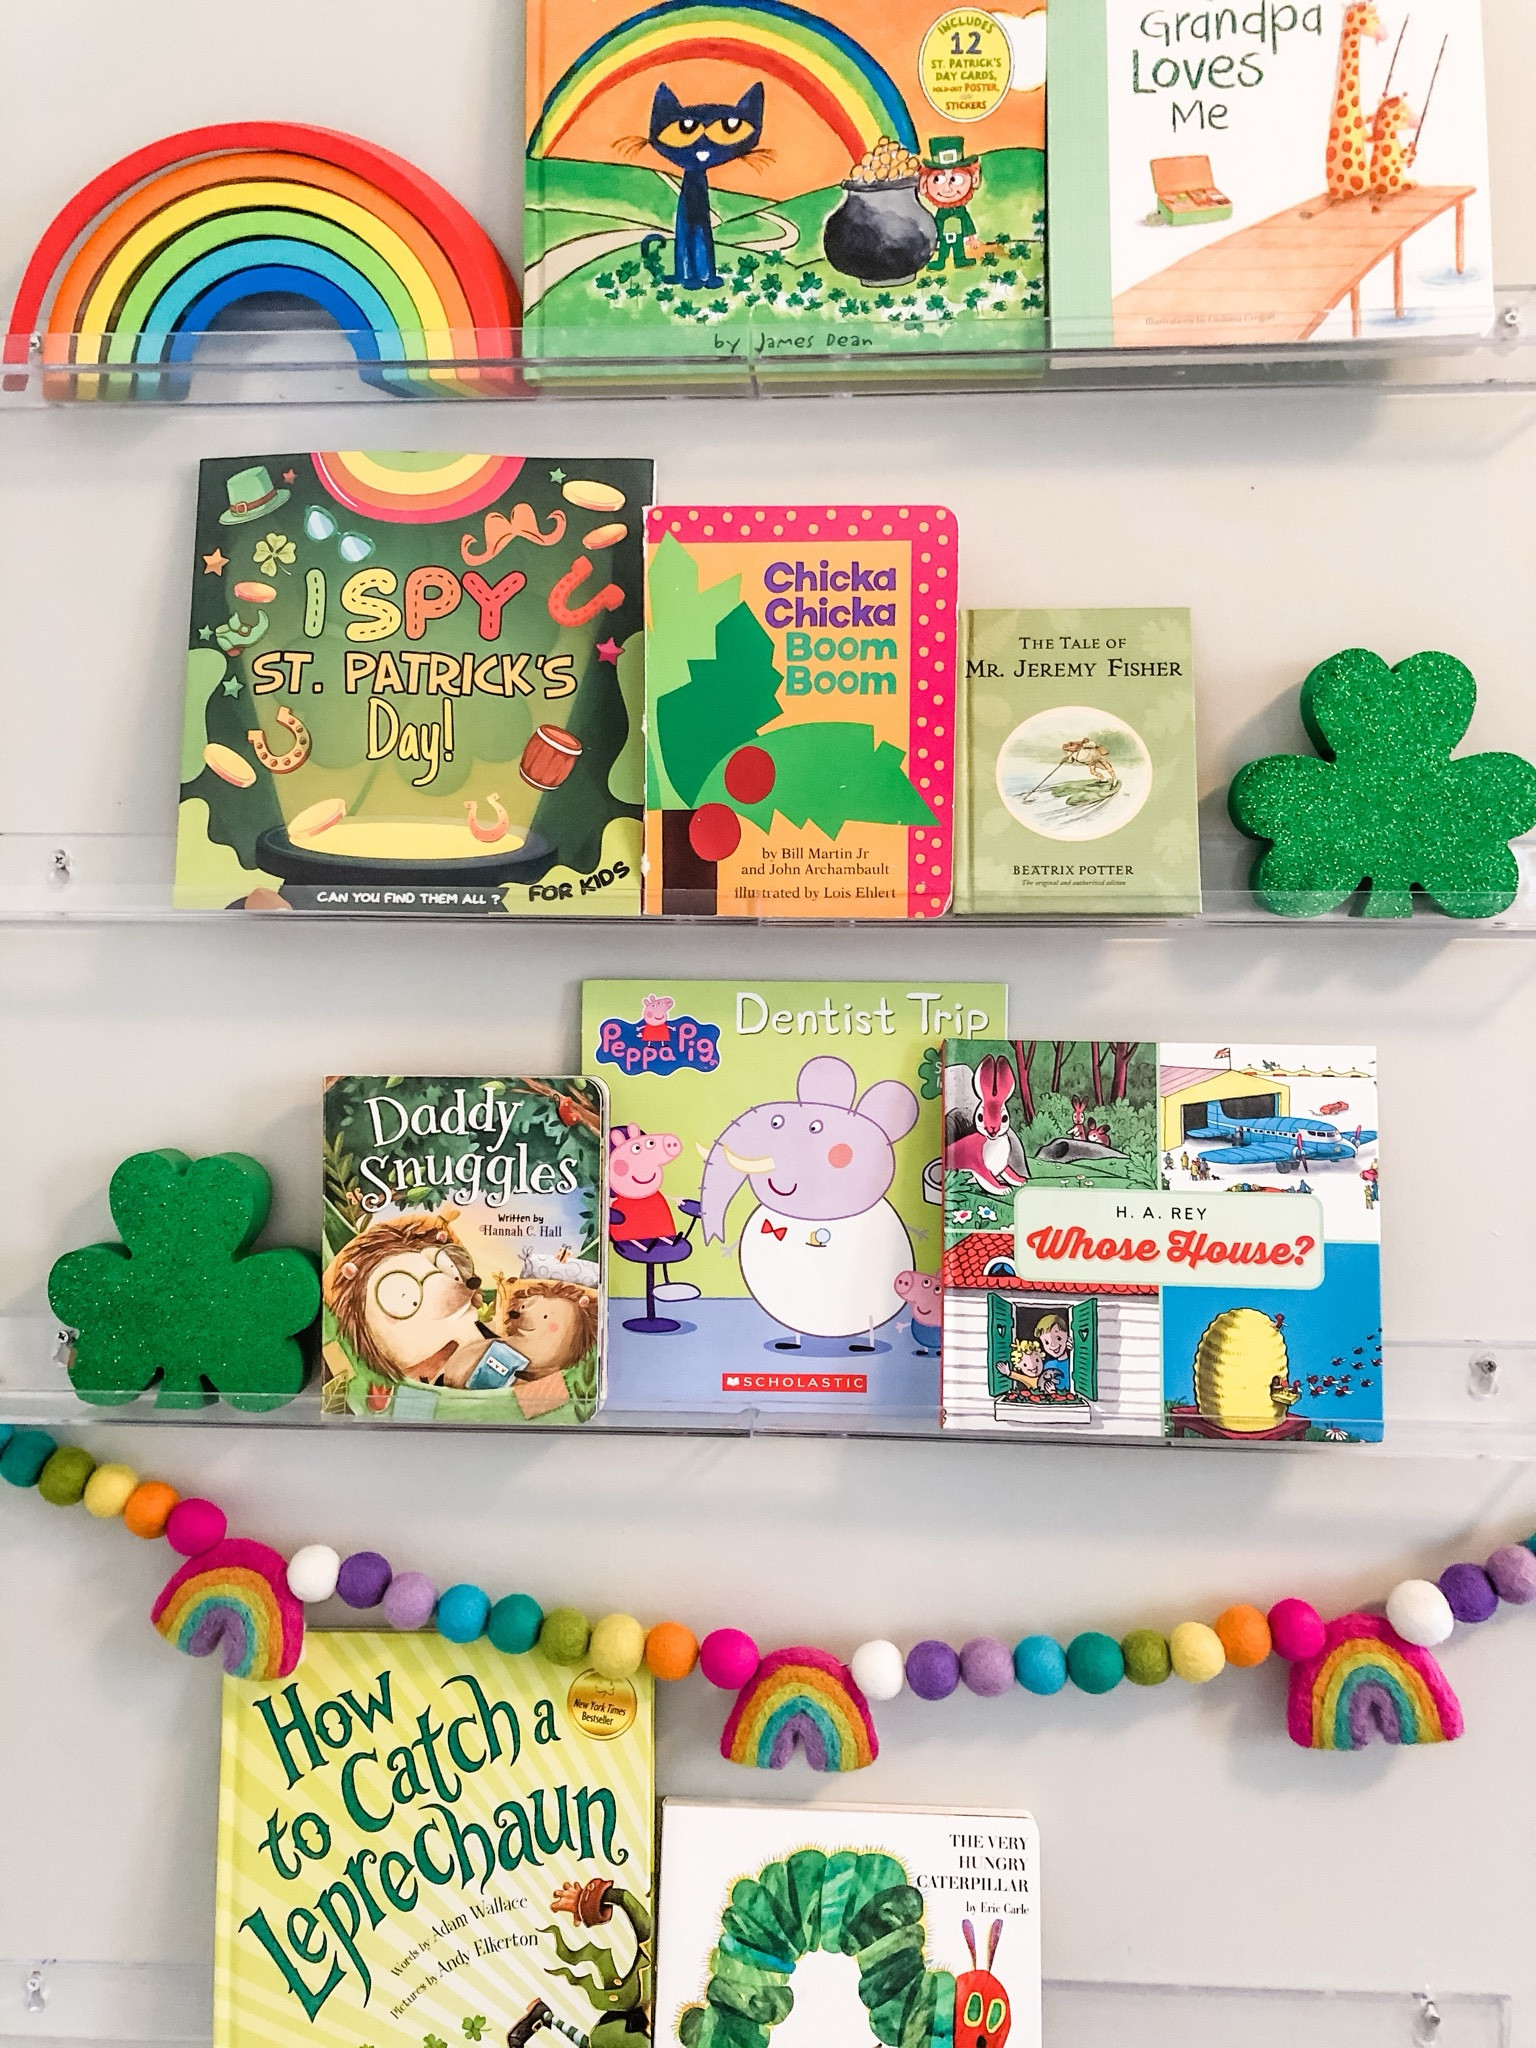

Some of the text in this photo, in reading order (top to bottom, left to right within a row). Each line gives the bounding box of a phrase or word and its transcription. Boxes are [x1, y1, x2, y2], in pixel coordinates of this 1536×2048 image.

[937, 16, 995, 35] INCLUDES
[1140, 0, 1322, 54] Grandpa
[951, 31, 982, 54] 12
[931, 57, 1002, 69] ST. PATRICK'S
[1133, 49, 1263, 94] Loves
[935, 70, 997, 82] DAY CARDS,
[964, 83, 1000, 92] POSTER,
[945, 101, 987, 110] STICKERS
[1172, 100, 1229, 132] Me
[714, 332, 873, 353] by James Dean
[763, 560, 897, 594] Chicka
[303, 565, 527, 643] I SPY
[764, 596, 897, 629] Chicka
[785, 632, 898, 662] Boom
[252, 651, 578, 699] ST. PATRICK'S
[1013, 659, 1098, 679] JEREMY
[1107, 657, 1183, 679] FISHER
[785, 665, 897, 696] Boom
[366, 697, 455, 787] Day!
[762, 847, 870, 862] by Bill Martin Jr
[741, 863, 889, 875] and John Archambault
[1013, 865, 1134, 875] BEATRIX POTTER
[528, 860, 630, 902] FOR KIDS
[1035, 879, 1059, 888] original
[317, 891, 349, 903] CAN
[353, 892, 381, 903] YOU
[384, 892, 414, 904] FIND
[420, 892, 459, 905] THEM
[461, 893, 487, 905] ALL
[734, 886, 896, 901] illustrated by Lois Ehlert
[735, 991, 990, 1039] Dentist Trip
[602, 1022, 718, 1071] Peppa Pig
[363, 1087, 523, 1152] Daddy
[360, 1143, 579, 1213] Snuggles
[497, 1213, 545, 1225] Written by
[1116, 1206, 1207, 1221] H. A. REY
[478, 1224, 562, 1237] Hannah C. Hall
[1026, 1225, 1316, 1271] Whose House?
[743, 1376, 865, 1389] SCHOLASTIC
[573, 1698, 627, 1716] New York Times
[581, 1711, 614, 1725] Bestseller
[252, 1670, 394, 1790] How
[258, 1674, 563, 1880] to Catch a
[949, 1834, 1028, 1850] THE VERY
[959, 1856, 1028, 1871] HUNGRY
[916, 1874, 1029, 1893] CATERPILLAR
[238, 1784, 629, 2024] Leprechaun
[966, 1901, 1029, 1915] by Eric Carle
[390, 1896, 528, 1977] Words by Adam Wallace
[389, 1933, 539, 2020] Pictures by Andy Elkerton
